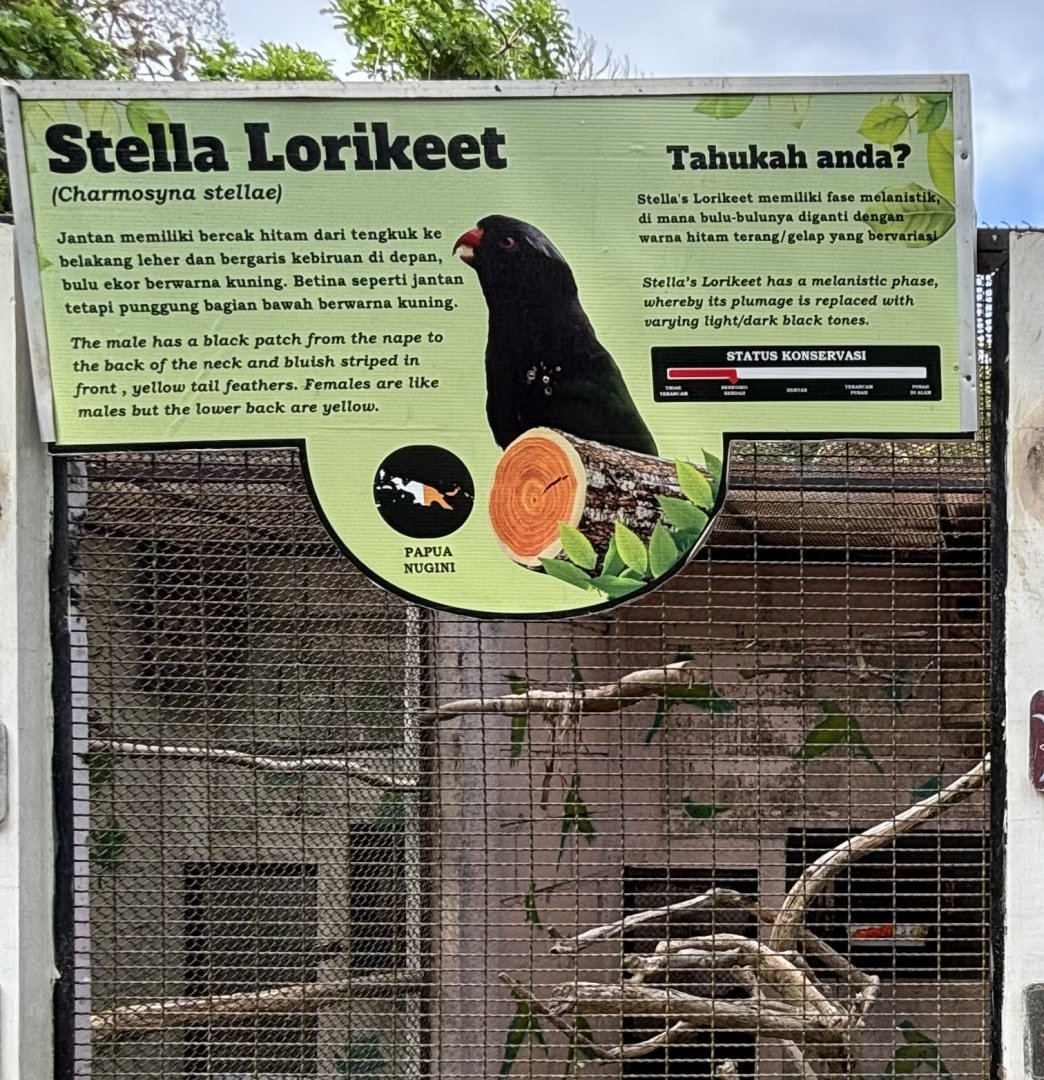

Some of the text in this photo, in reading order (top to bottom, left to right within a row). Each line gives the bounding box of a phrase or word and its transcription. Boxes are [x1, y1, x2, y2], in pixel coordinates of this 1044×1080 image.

[44, 122, 508, 175] Stella Lorikeet
[665, 143, 912, 171] Tahukah anda?
[51, 183, 283, 207] (Charmosyna stellae)
[693, 192, 754, 204] Lorikeet
[758, 191, 823, 204] memiliki
[826, 190, 855, 203] fase
[859, 190, 942, 206] melanistik,
[638, 210, 906, 226] di mana bulu-bulunya diganti dengan
[56, 226, 442, 245] Jantan memiliki bercak hitam dari tengkuk ke
[58, 250, 443, 270] belakang leher dan bergaris kebiruan di depan,
[701, 275, 763, 288] Lorikeet
[766, 275, 793, 287] has
[797, 277, 807, 287] a
[811, 274, 888, 287] melanistic
[890, 274, 939, 290] phase,
[64, 295, 458, 318] tetapi punggung bagian bawah berwarna kuning.
[643, 294, 915, 311] whereby its plumage is replaced with
[644, 314, 870, 330] varying light/dark black tones.
[70, 331, 444, 350] The male has black patch from the nape to
[72, 353, 421, 375] the back of the neck and bluish striped in
[726, 350, 867, 362] STATUS KONSERVASI
[72, 376, 440, 399] front yellow tail feathers. Females are like
[77, 399, 379, 418] males but the lower back are yellow.
[404, 546, 454, 558] PAPUA
[403, 562, 456, 574] NUGINI
